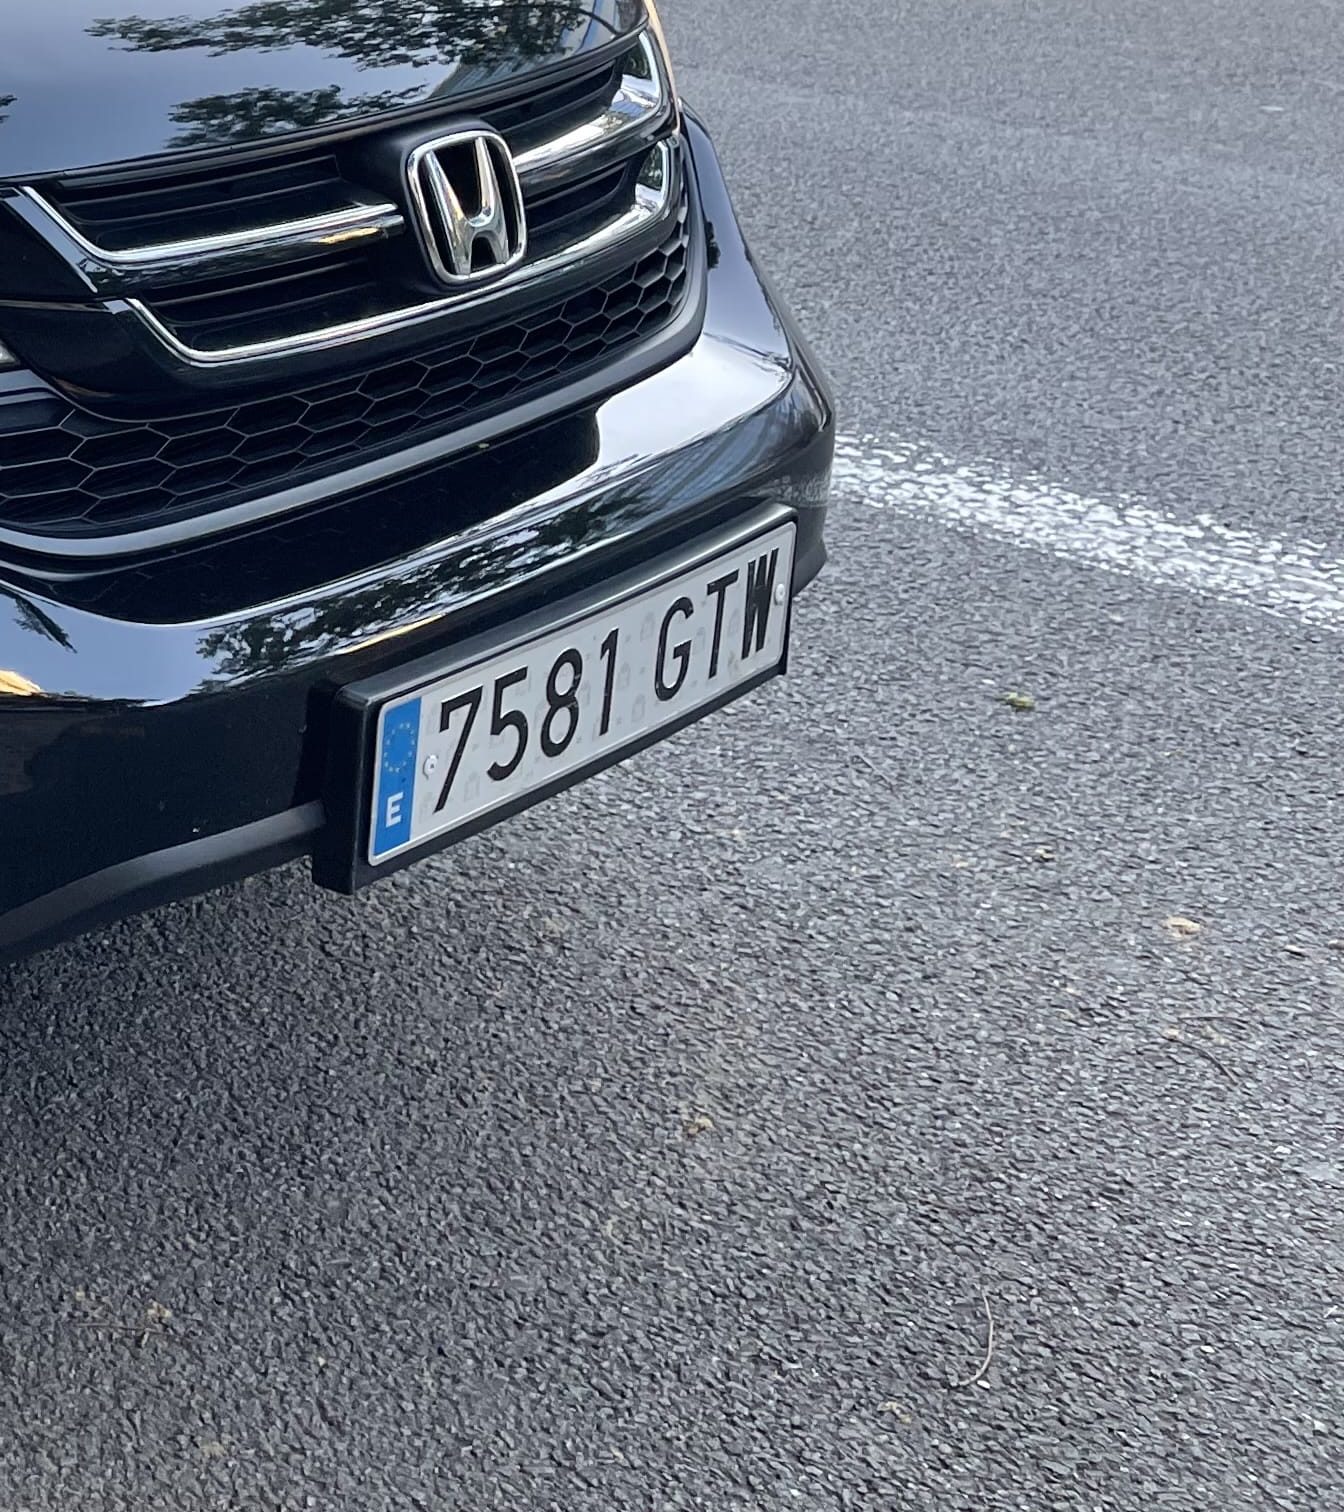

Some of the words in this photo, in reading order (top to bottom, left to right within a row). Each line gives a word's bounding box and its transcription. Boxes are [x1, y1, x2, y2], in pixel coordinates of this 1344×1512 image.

[433, 627, 620, 814] 7581
[653, 546, 780, 702] GTW
[384, 791, 404, 828] E
